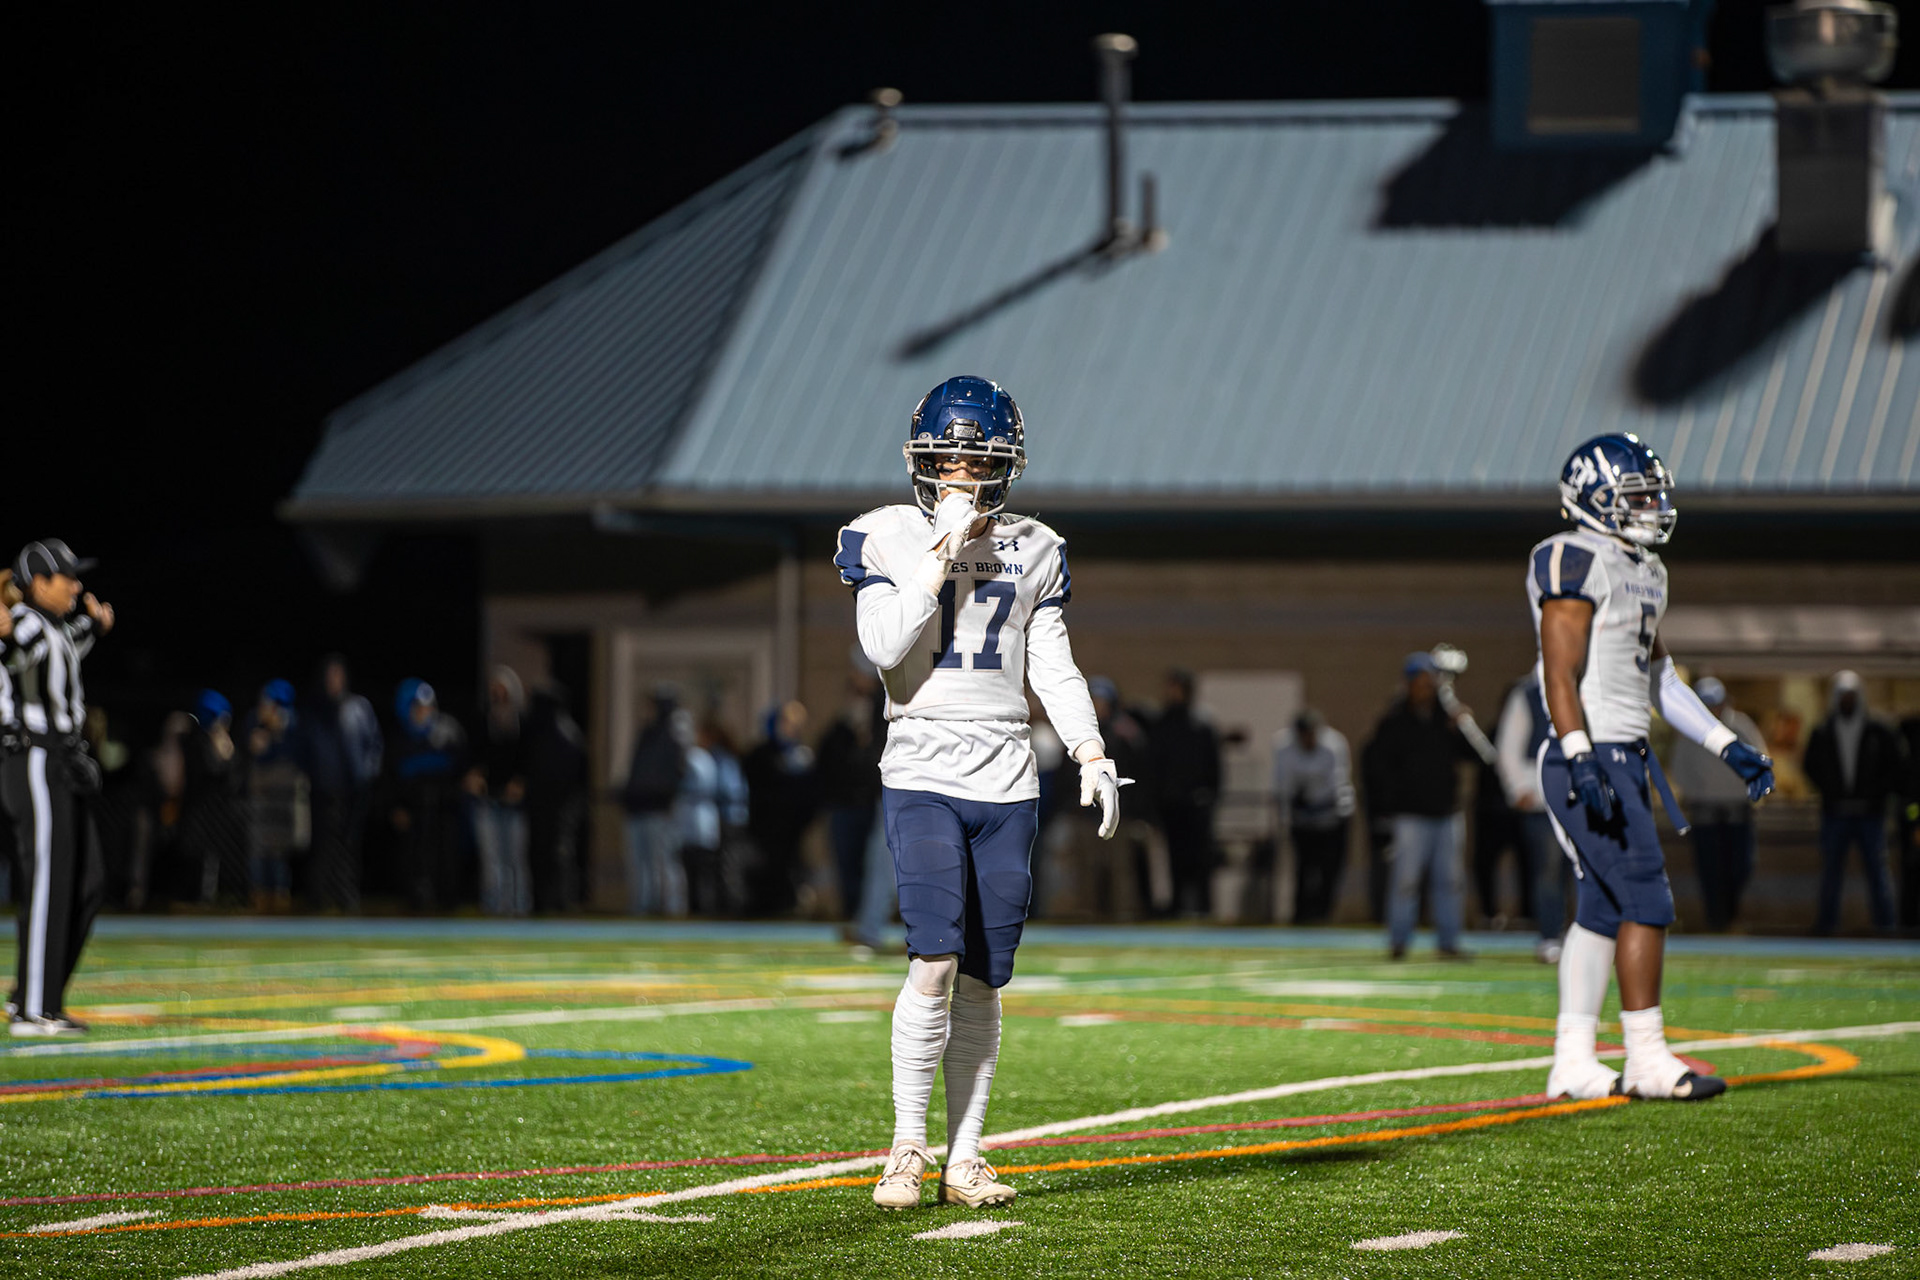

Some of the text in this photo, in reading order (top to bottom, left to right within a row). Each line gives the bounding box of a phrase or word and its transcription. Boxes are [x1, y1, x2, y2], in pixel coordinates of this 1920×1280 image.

[951, 561, 1023, 575] ES BROWN
[932, 578, 1017, 670] 17
[1635, 602, 1657, 674] 5
